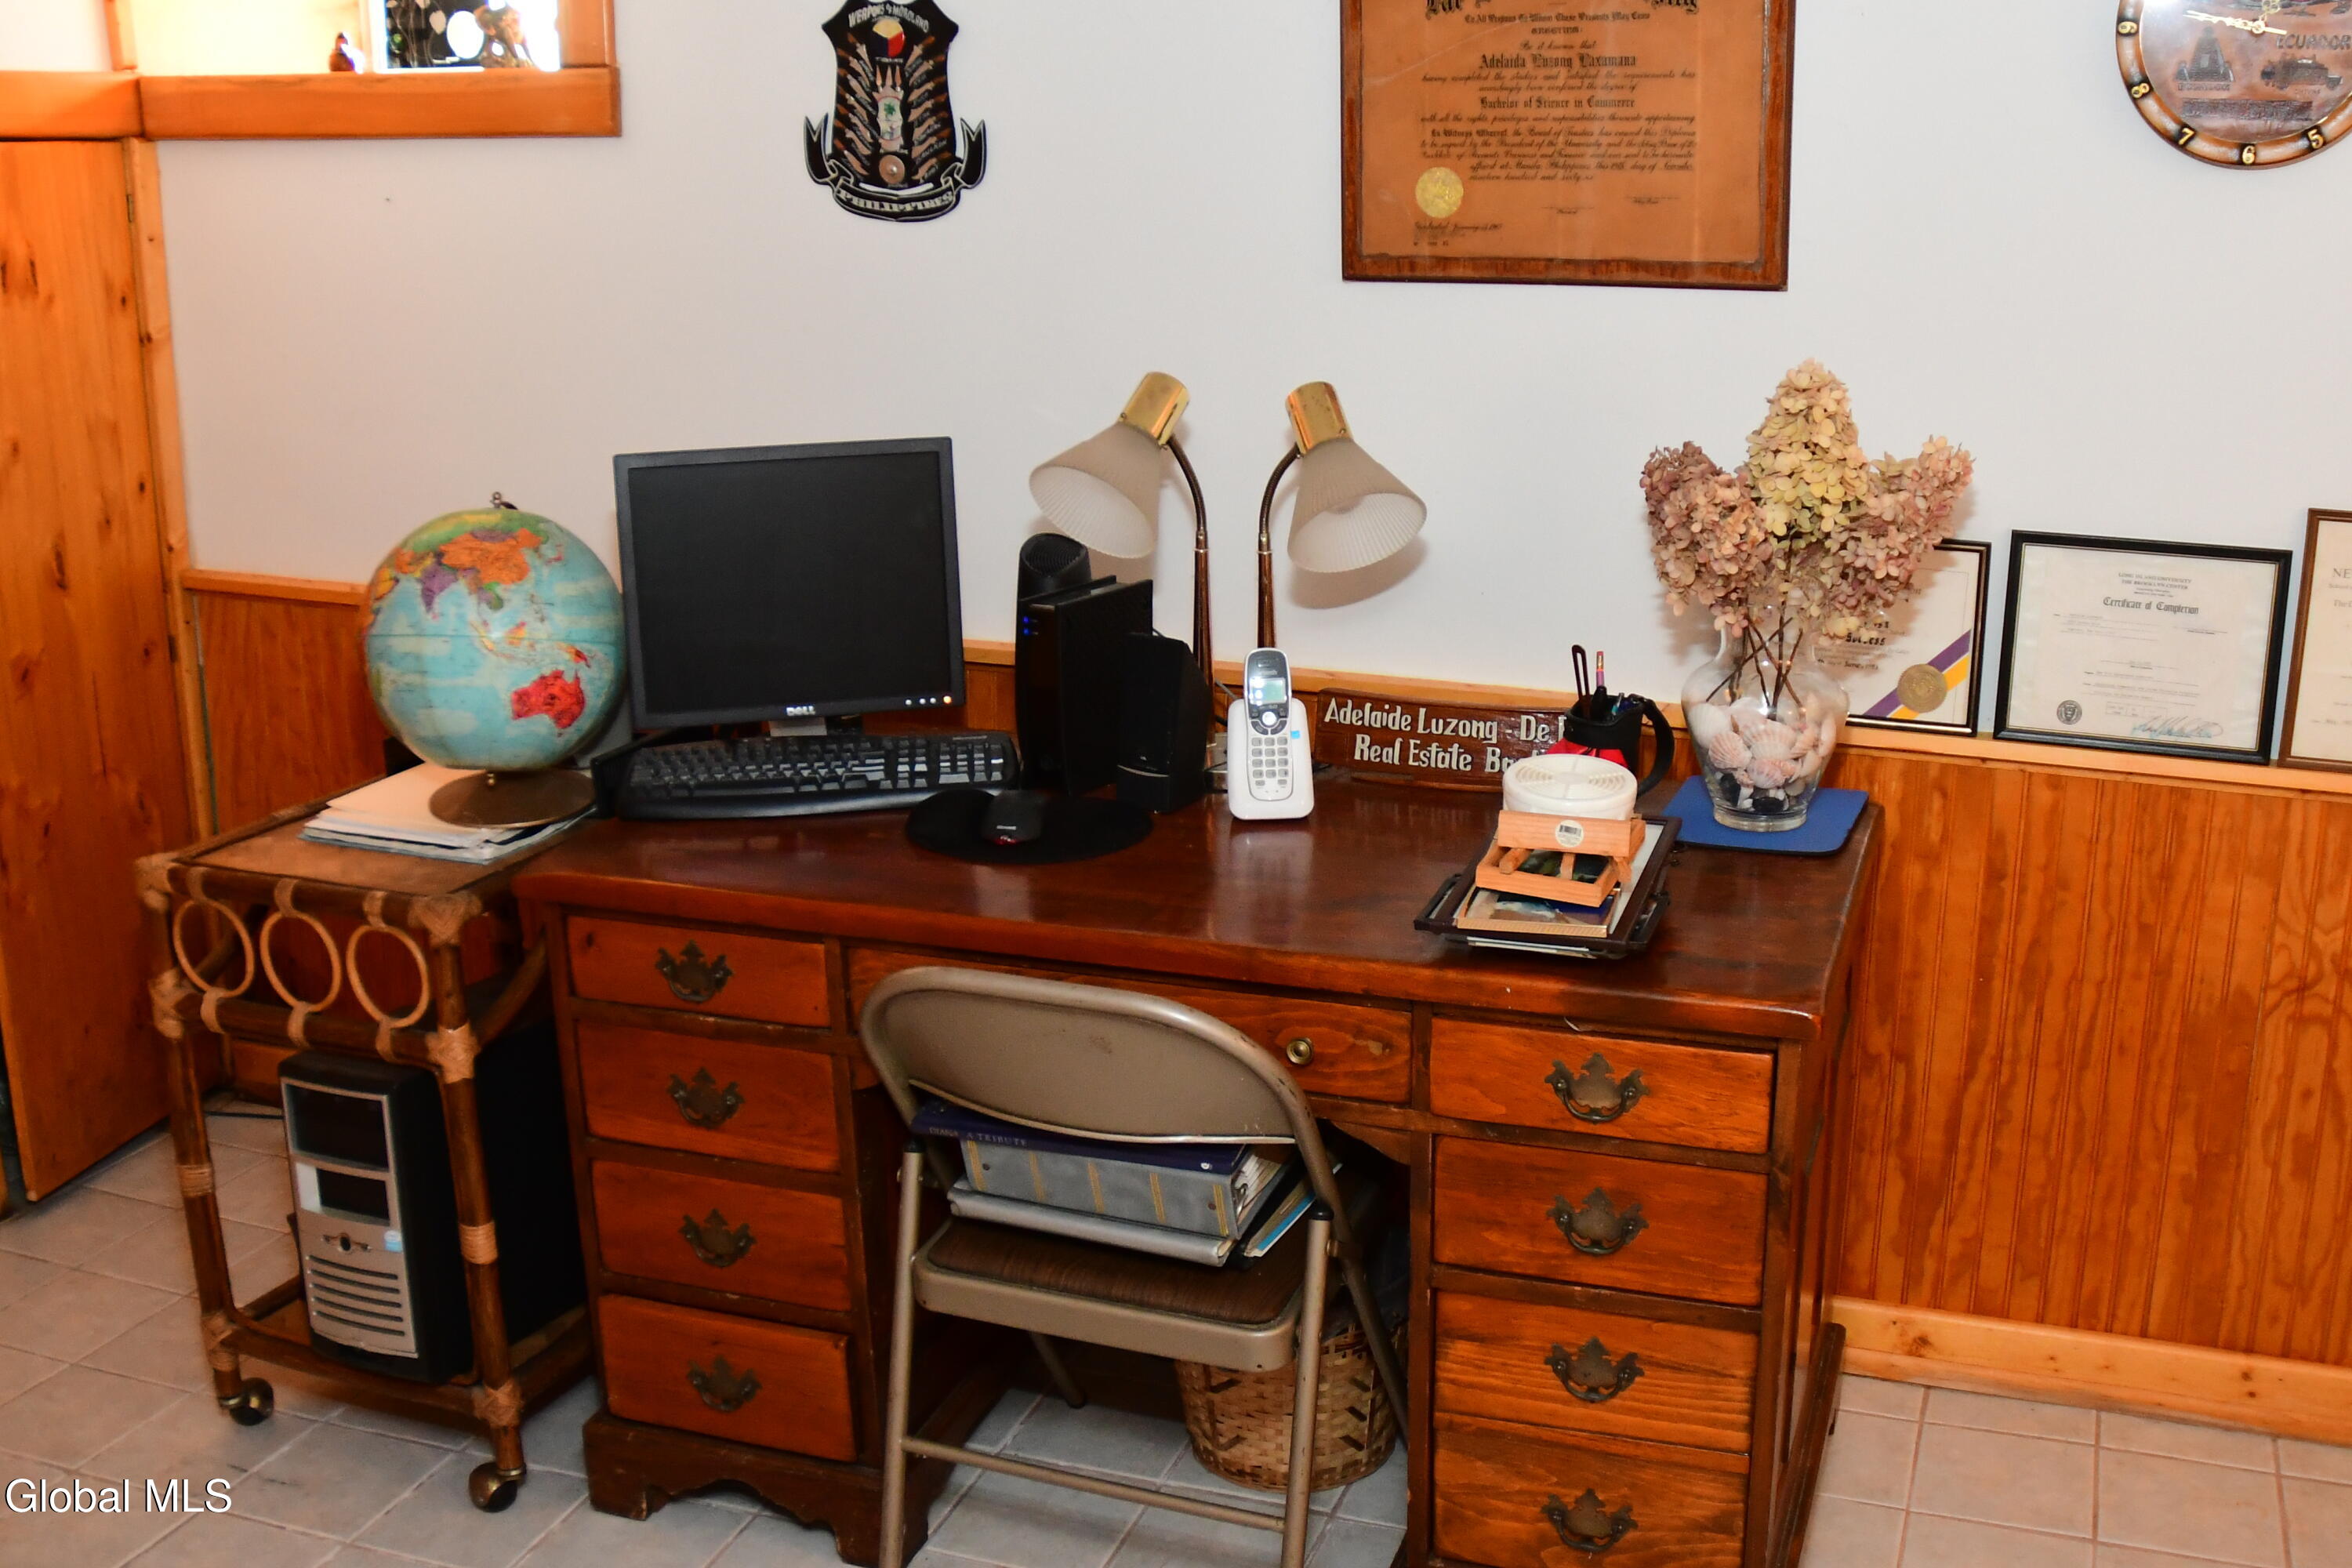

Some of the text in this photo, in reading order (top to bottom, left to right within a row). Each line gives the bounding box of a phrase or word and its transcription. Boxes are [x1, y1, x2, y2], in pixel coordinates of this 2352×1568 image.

[848, 5, 885, 28] WEAPONS
[893, 5, 929, 33] MOROLAND
[2118, 21, 2138, 34] 9
[2276, 34, 2351, 50] ECUADOR
[1479, 53, 1526, 69] Adelaida
[2131, 82, 2151, 99] 8
[1480, 96, 1519, 108] Bachelor
[1524, 96, 1534, 108] of
[1536, 96, 1569, 108] Science
[1587, 95, 1635, 108] Commerce
[2179, 127, 2194, 146] 7
[2307, 129, 2324, 149] 5
[2242, 145, 2256, 165] 6
[839, 188, 953, 212] PHILIPPINES
[2103, 596, 2199, 615] Certificate of Completion
[786, 705, 816, 717] DELL
[1324, 697, 1412, 731] Adelaide
[1417, 706, 1498, 744] Luzong
[1519, 714, 1551, 742] De
[1354, 733, 1403, 766] Real
[1408, 739, 1472, 771] Estate
[978, 1133, 1028, 1146] TRIBUTE
